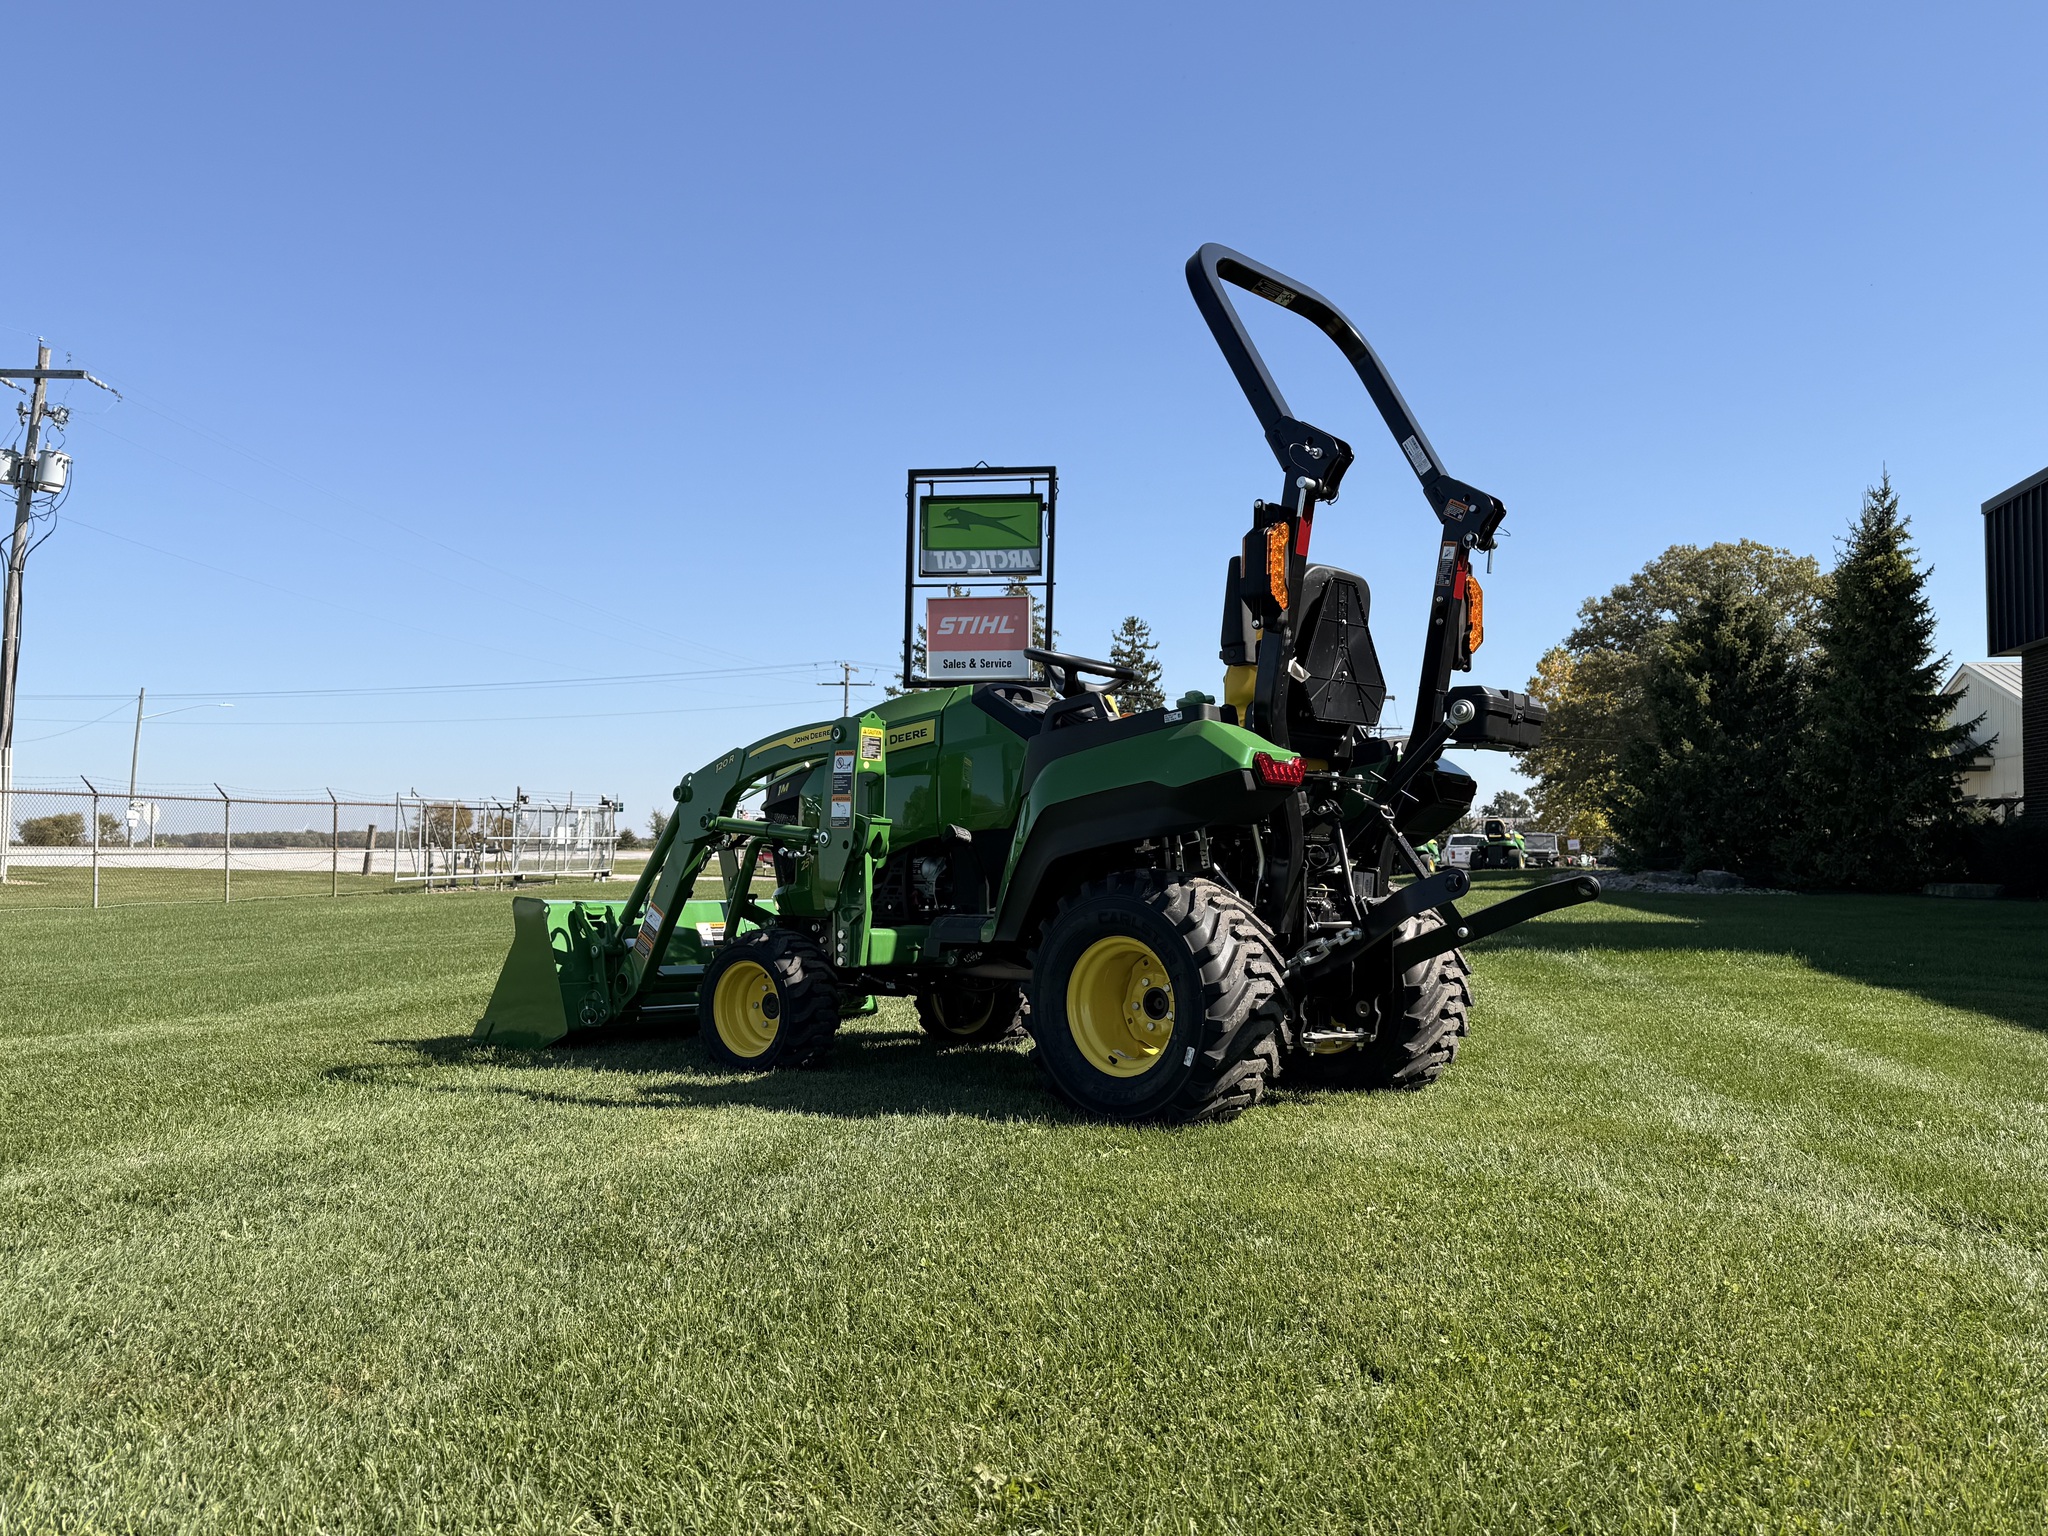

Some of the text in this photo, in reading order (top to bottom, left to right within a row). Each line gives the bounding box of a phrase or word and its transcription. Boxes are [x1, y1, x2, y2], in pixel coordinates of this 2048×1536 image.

[937, 615, 1015, 635] STIHL
[943, 658, 1012, 669] Sales & Service
[793, 729, 831, 744] JOHN DEERE
[890, 728, 928, 745] DEERE
